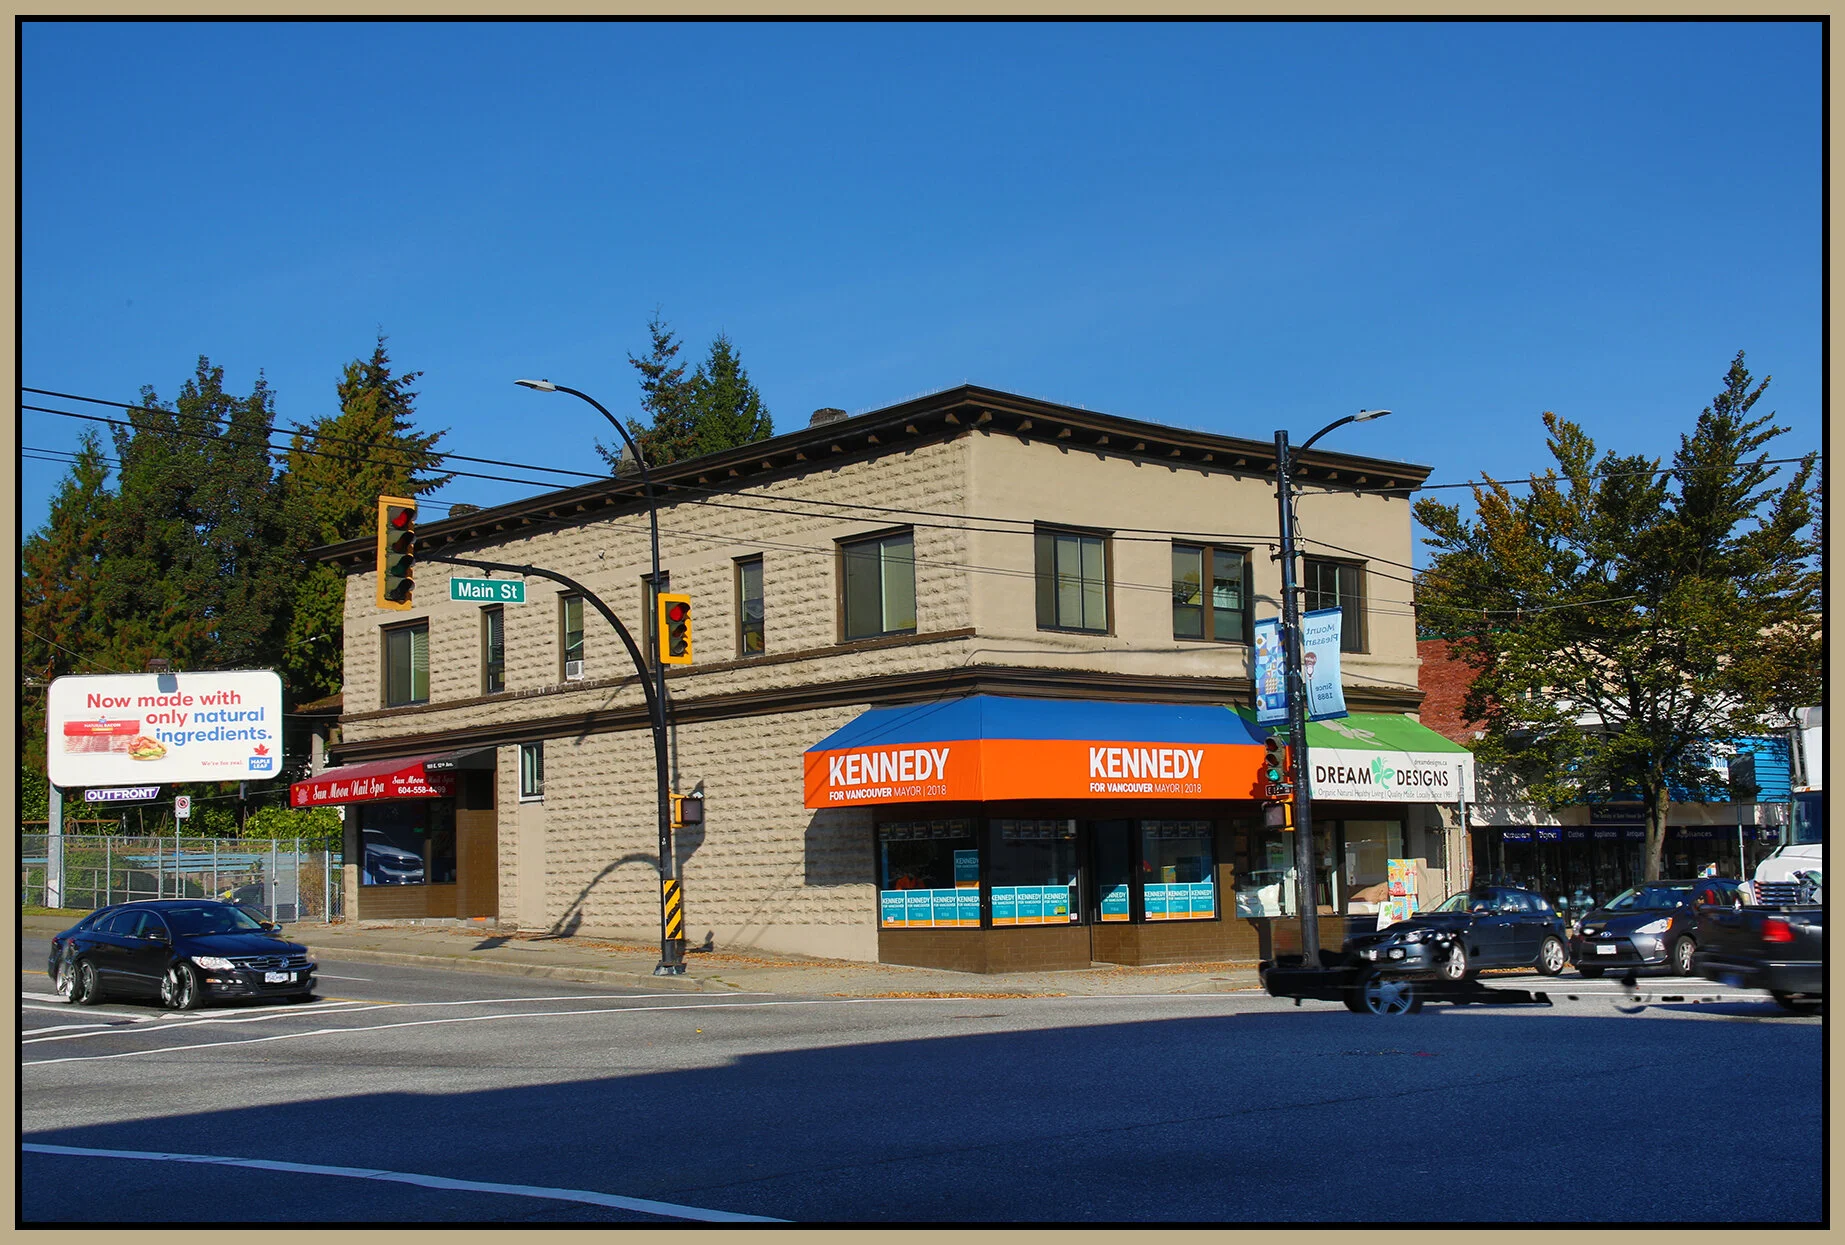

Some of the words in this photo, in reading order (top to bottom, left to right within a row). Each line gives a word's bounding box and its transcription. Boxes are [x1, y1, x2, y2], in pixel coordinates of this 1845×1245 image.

[458, 582, 494, 598] Main
[501, 584, 518, 599] St
[87, 693, 131, 708] Now
[137, 691, 194, 707] made
[199, 690, 241, 705] with
[146, 709, 188, 727] only
[194, 707, 265, 724] natural
[156, 726, 273, 747] ingredients.
[829, 748, 950, 787] KENNEDY
[1089, 747, 1204, 779] KENNEDY
[392, 776, 405, 784] Sun
[406, 775, 424, 784] Moon
[1316, 766, 1372, 784] DREAM
[1397, 770, 1449, 786] DESIGNS
[87, 789, 156, 800] OUTFRONT
[312, 784, 327, 800] Sun
[328, 783, 349, 799] Moon
[351, 779, 369, 796] Nail
[369, 778, 385, 797] Spa
[829, 791, 844, 801] FOR
[845, 787, 892, 800] VANCOUVER
[893, 786, 921, 797] MAYOR
[927, 785, 947, 796] 2018
[1089, 783, 1105, 793] FOR
[1106, 783, 1153, 793] VANCOUVER
[1154, 784, 1180, 793] MAYOR
[1185, 784, 1202, 793] 2018
[1337, 788, 1354, 797] Natural
[1371, 790, 1384, 799] Living
[1386, 790, 1402, 799] Quality
